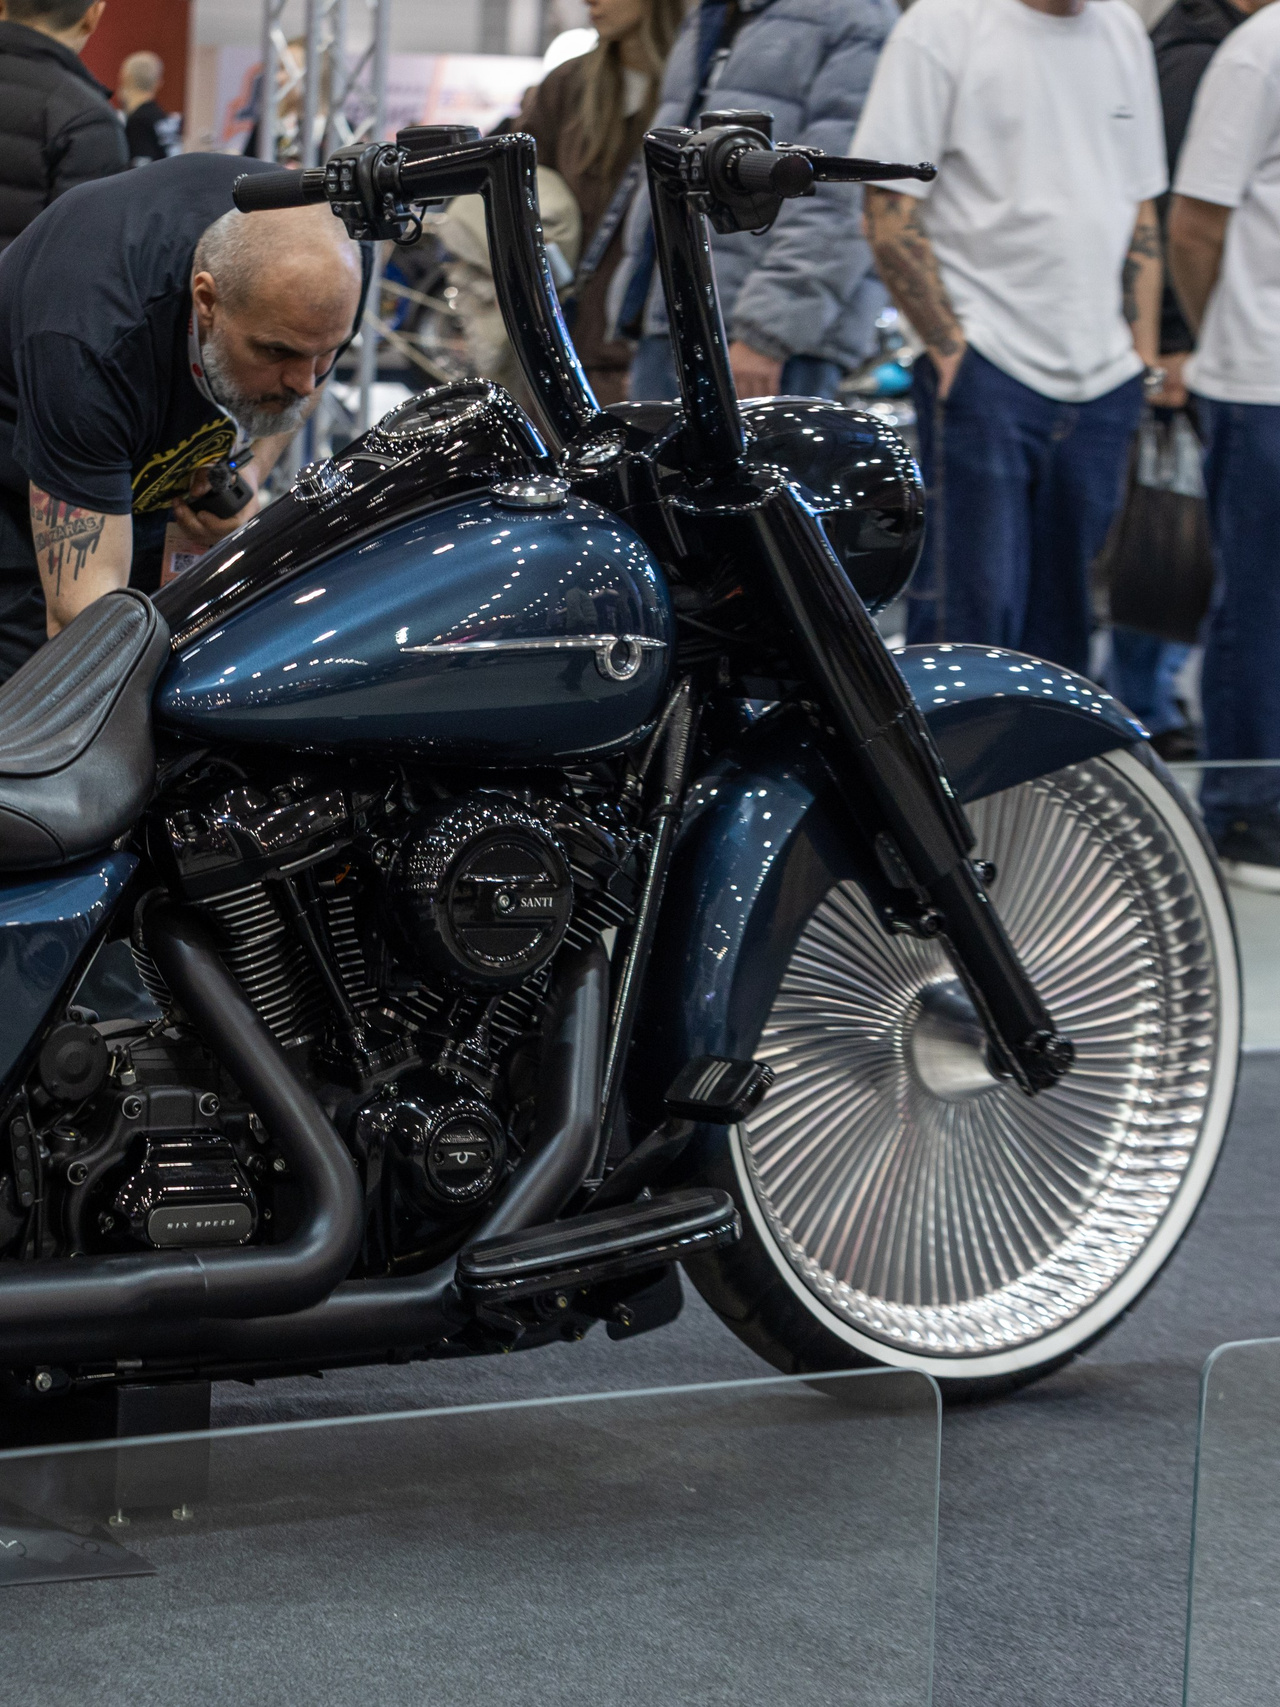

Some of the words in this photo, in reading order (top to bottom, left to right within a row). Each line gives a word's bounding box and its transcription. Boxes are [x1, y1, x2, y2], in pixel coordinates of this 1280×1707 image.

[520, 897, 553, 908] SANTI
[167, 1222, 188, 1230] SIX
[196, 1219, 235, 1229] SPEED
